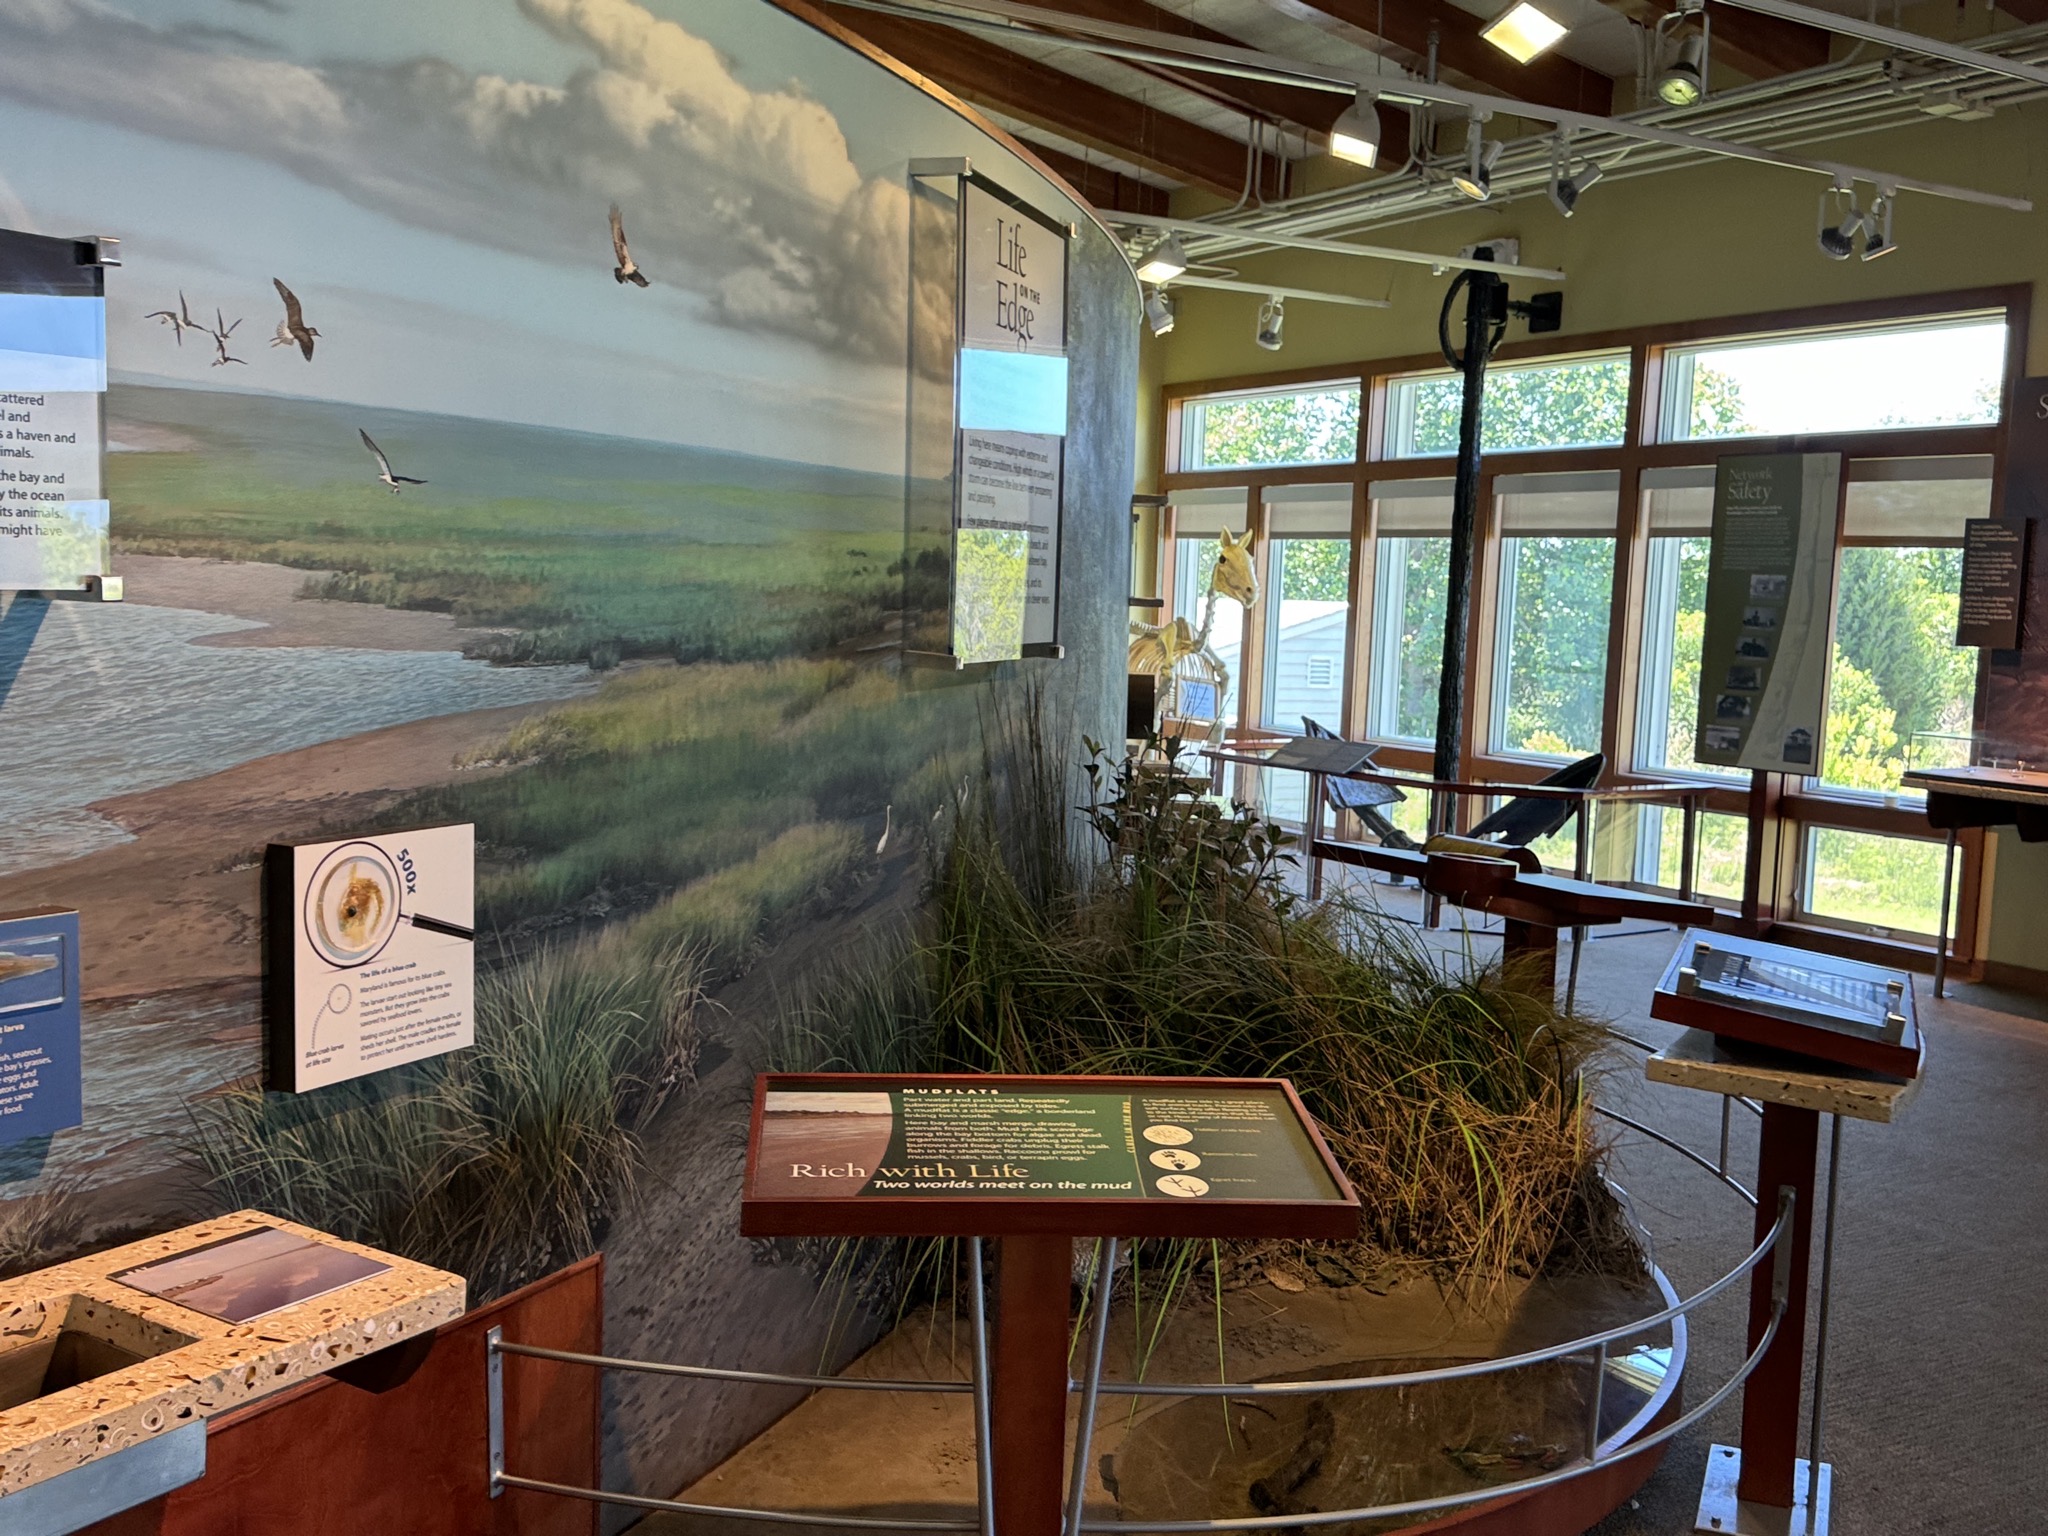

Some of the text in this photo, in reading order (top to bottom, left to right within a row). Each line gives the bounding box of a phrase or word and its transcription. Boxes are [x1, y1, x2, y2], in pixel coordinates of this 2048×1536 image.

[996, 217, 1027, 278] Life
[1020, 284, 1040, 304] ON THE
[996, 279, 1034, 352] Edge
[0, 394, 44, 406] attered
[8, 412, 30, 422] and
[6, 430, 13, 440] a
[16, 428, 52, 442] haven
[54, 432, 76, 444] and
[19, 470, 40, 485] bay
[43, 473, 64, 484] and
[8, 488, 28, 500] the
[30, 492, 64, 501] ocean
[1728, 482, 1772, 504] Safety
[16, 506, 64, 519] animals.
[36, 524, 62, 536] have
[396, 848, 417, 895] 500x
[4, 1024, 25, 1032] larva
[3, 1068, 37, 1083] eggs and
[13, 1092, 34, 1103] same
[790, 1163, 1030, 1178] Rich with Life
[874, 1180, 910, 1189] Two
[914, 1180, 974, 1189] worlds
[979, 1181, 1025, 1189] meet
[1058, 1181, 1087, 1189] the
[1091, 1181, 1132, 1189] mud
